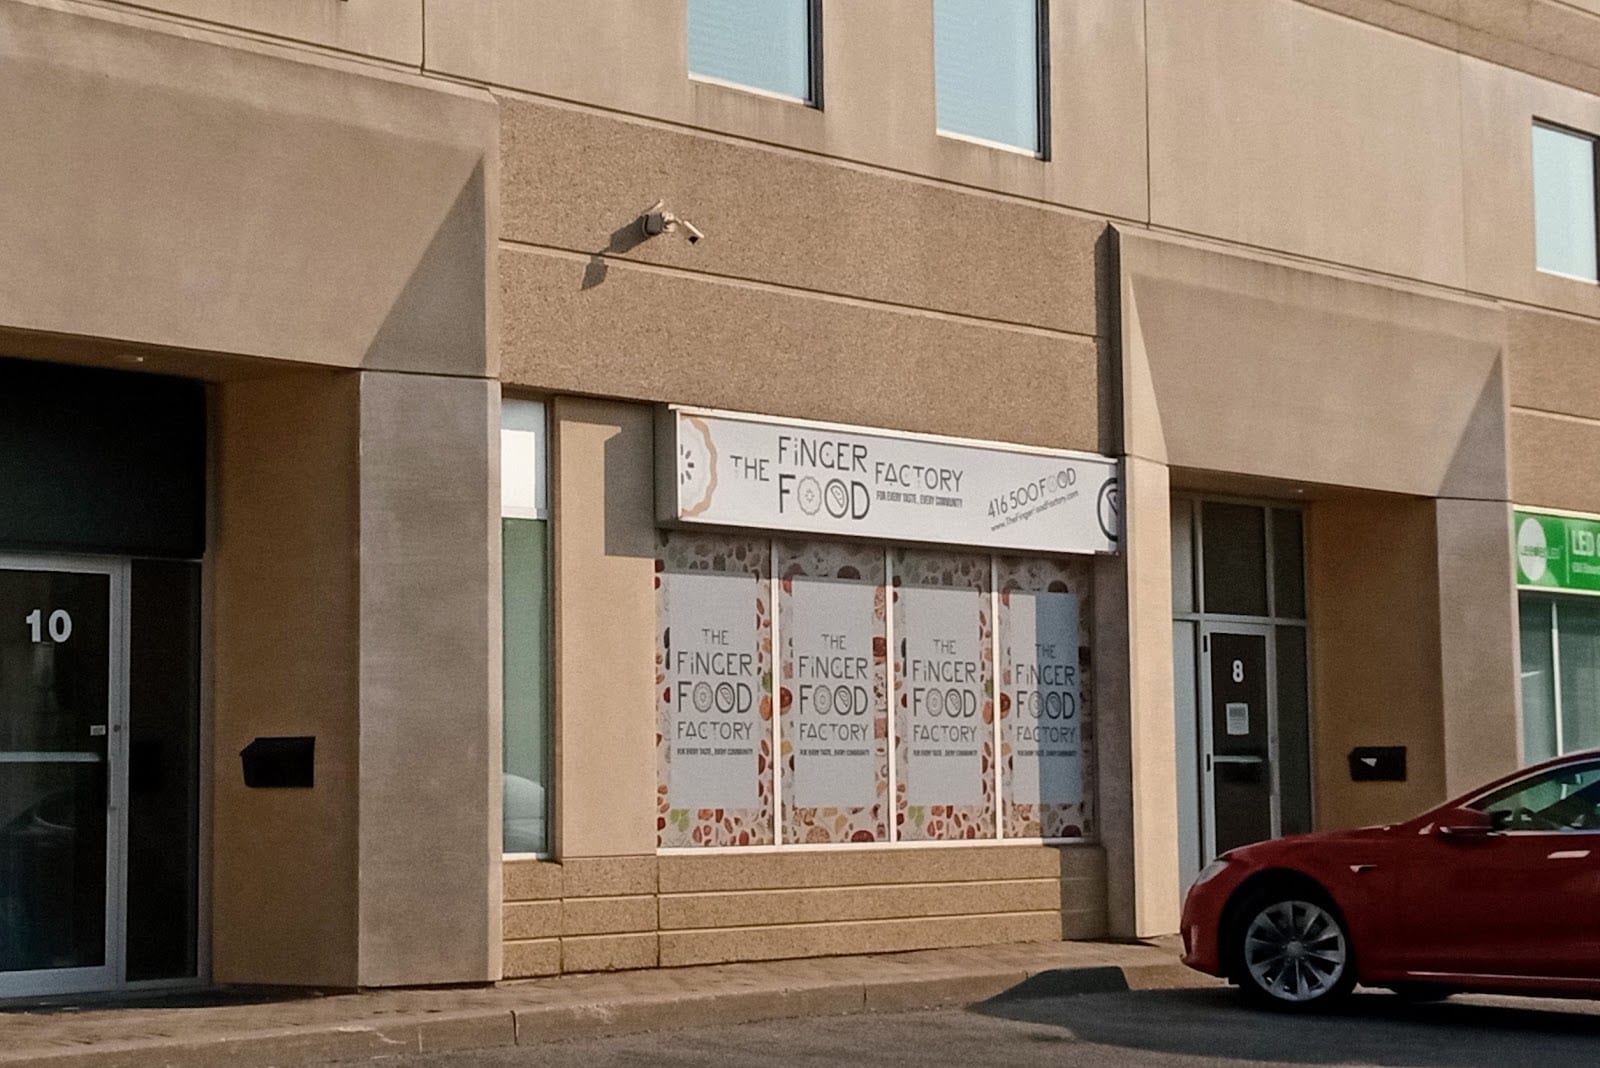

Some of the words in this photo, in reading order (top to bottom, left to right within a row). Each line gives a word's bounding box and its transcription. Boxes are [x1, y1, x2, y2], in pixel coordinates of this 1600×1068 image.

[730, 455, 770, 482] THE
[875, 462, 963, 493] FACTORY
[778, 474, 870, 520] FOOD
[26, 609, 72, 643] 10
[702, 628, 729, 646] THE
[821, 634, 847, 650] THE
[933, 638, 957, 655] THE
[1035, 643, 1057, 659] THE
[1232, 660, 1244, 682] 8
[677, 681, 753, 714] FOOD
[799, 684, 869, 716] FOOD
[913, 687, 977, 718] FOOD
[1016, 690, 1076, 720] FOOD
[677, 721, 754, 741] FACTORY
[799, 723, 869, 742] FACTORY
[913, 724, 978, 743] FACTORY
[1016, 726, 1076, 743] FACTORY
